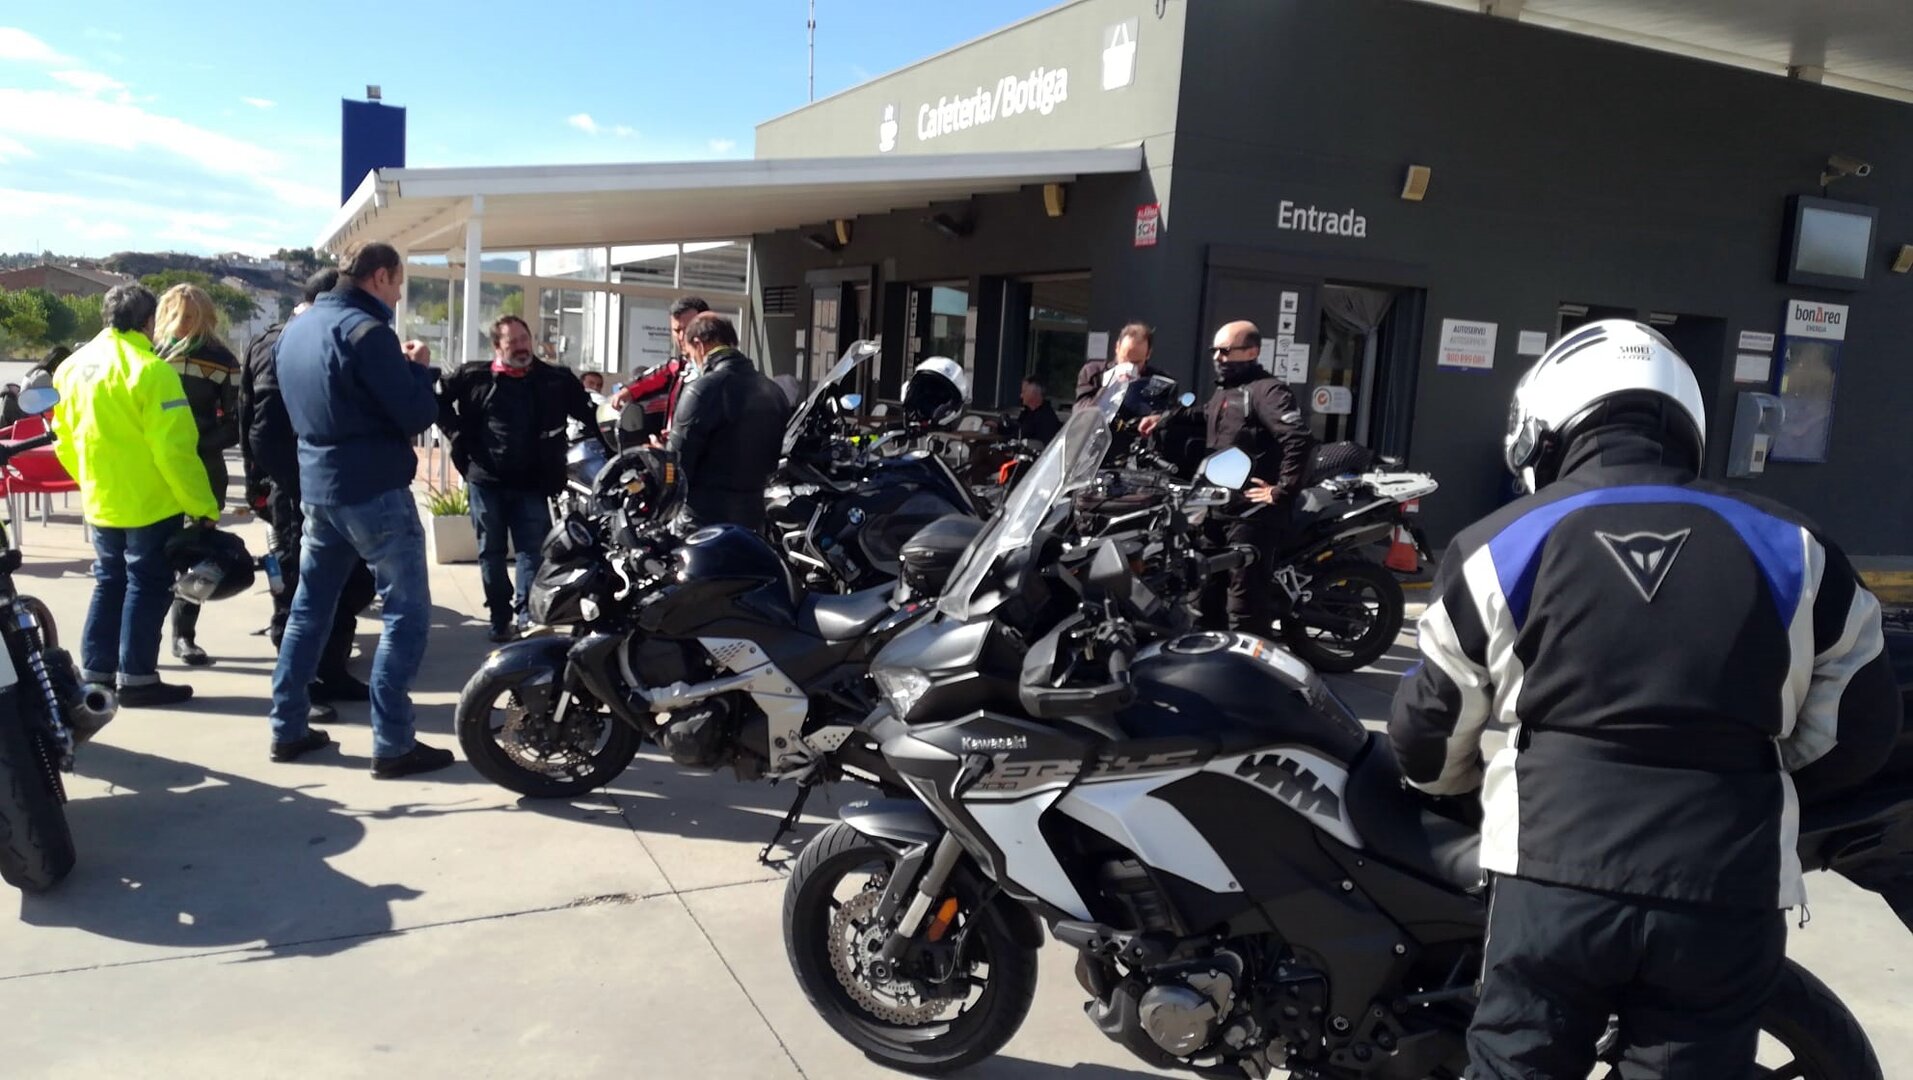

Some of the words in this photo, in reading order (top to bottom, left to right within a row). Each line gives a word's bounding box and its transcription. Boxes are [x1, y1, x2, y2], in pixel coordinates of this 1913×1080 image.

[917, 66, 1068, 142] Cafeteria/Botiga
[1277, 199, 1367, 239] Entrada
[1619, 345, 1651, 355] SHOEI
[961, 735, 1027, 750] Kawasaki
